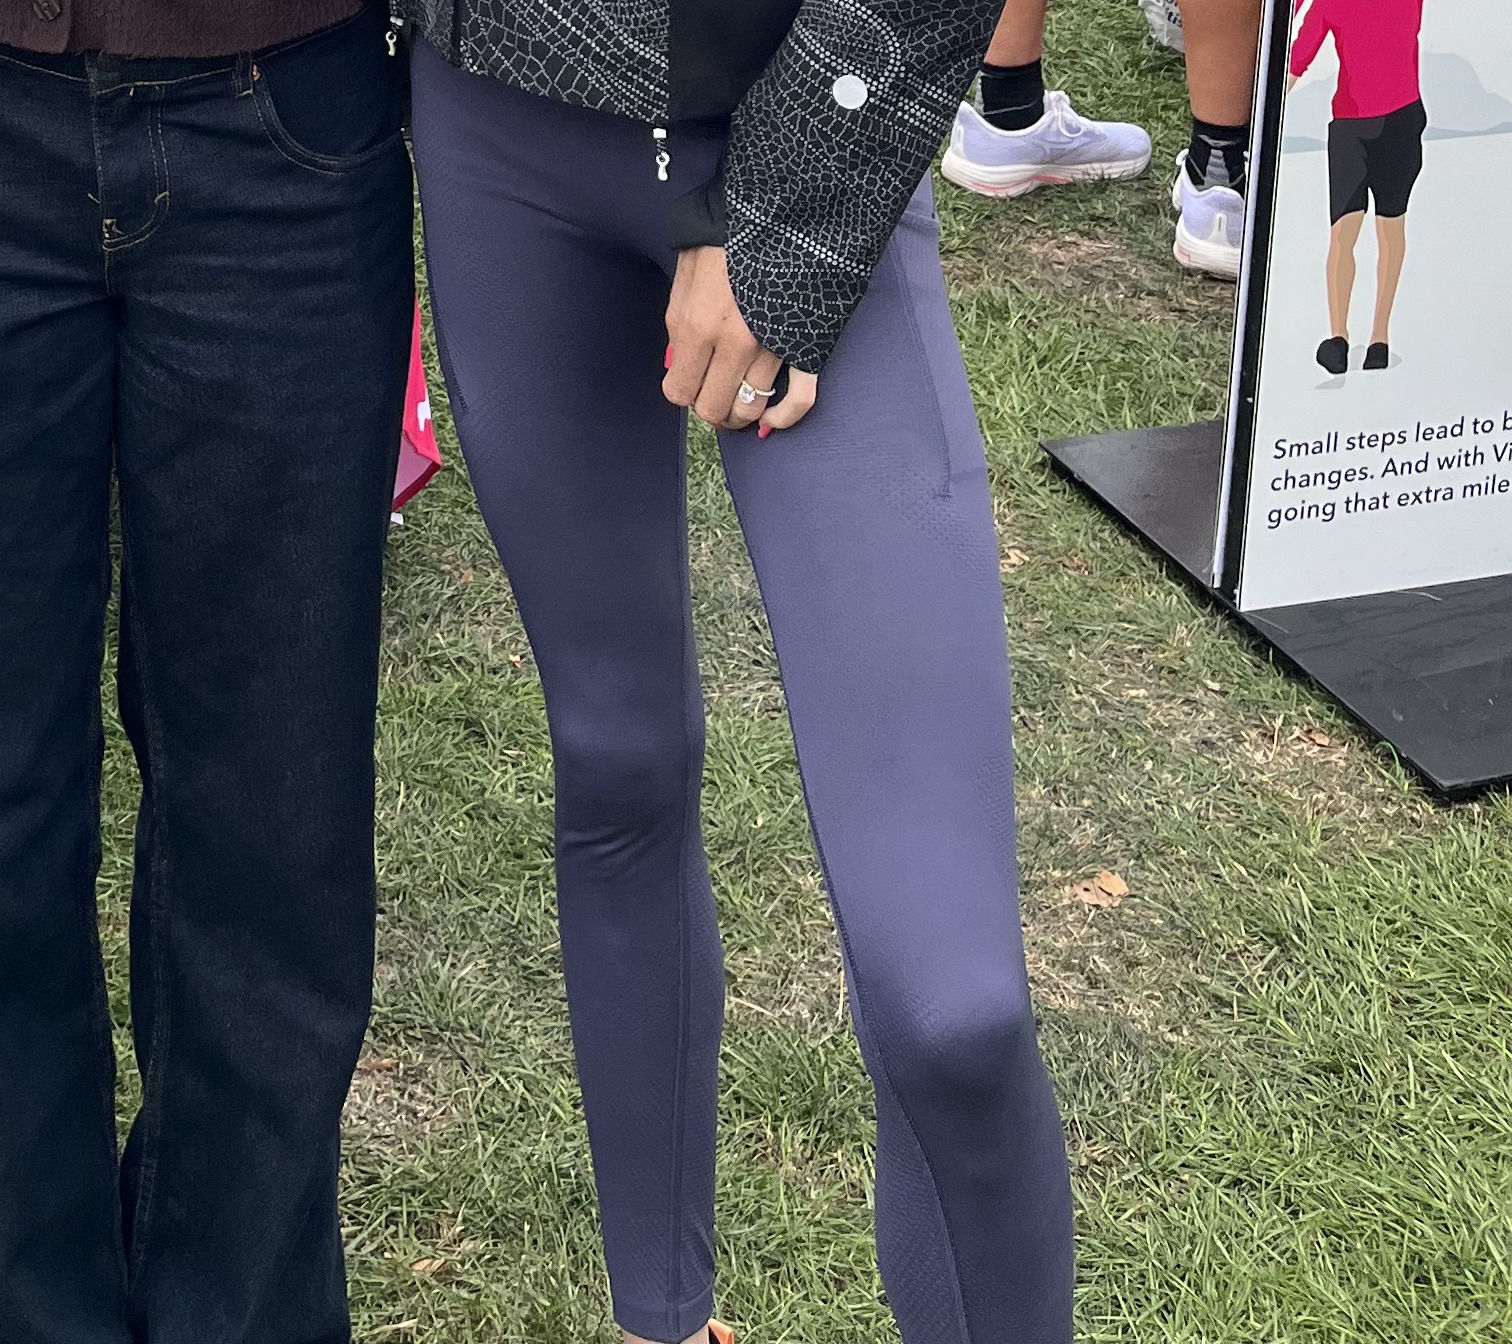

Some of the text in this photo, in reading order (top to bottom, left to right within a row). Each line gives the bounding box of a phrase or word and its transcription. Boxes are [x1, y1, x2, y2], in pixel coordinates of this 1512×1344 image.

[1273, 431, 1338, 459] Small
[1345, 429, 1407, 453] steps
[1415, 416, 1465, 442] lead
[1472, 417, 1495, 435] to
[1270, 468, 1374, 491] changes.
[1381, 452, 1428, 478] And
[1437, 445, 1484, 470] with
[1267, 473, 1510, 529] going that extra mile
